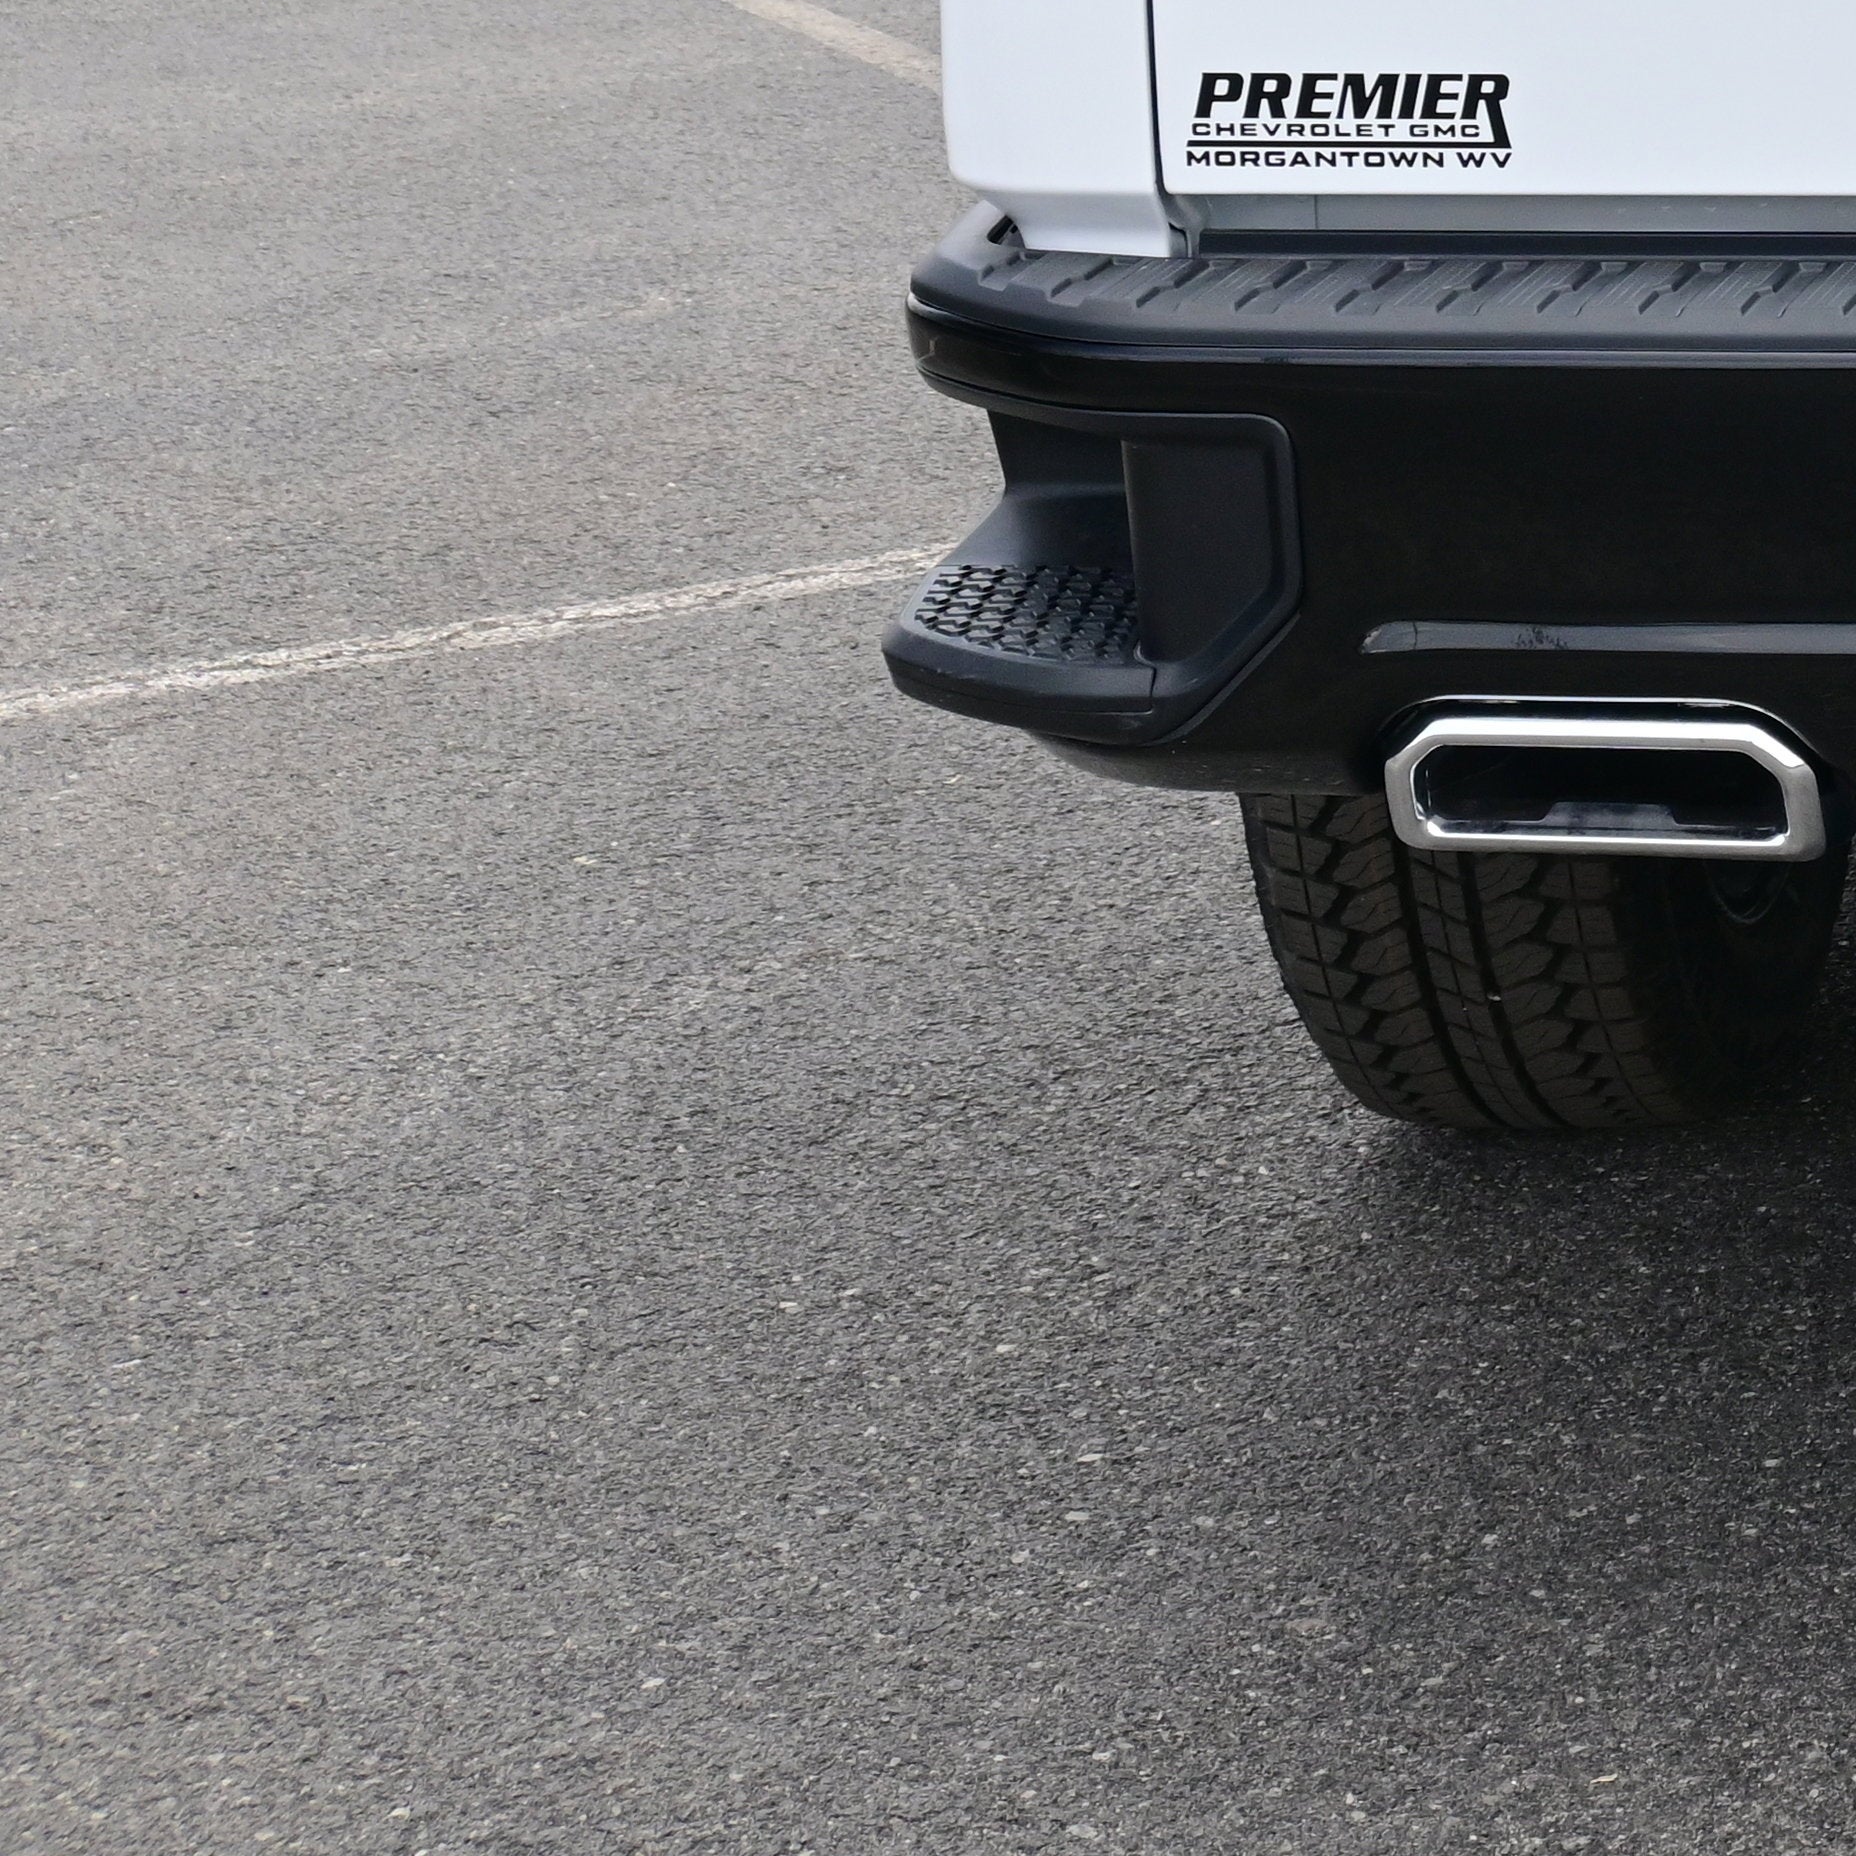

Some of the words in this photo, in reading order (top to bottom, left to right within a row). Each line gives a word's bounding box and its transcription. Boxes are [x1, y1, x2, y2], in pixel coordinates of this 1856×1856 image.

[1194, 72, 1510, 120] PREMIER
[1191, 122, 1396, 138] CHEVROLET
[1409, 123, 1481, 138] GMC
[1186, 150, 1444, 168] MORGANTOWN
[1455, 151, 1513, 169] WV
